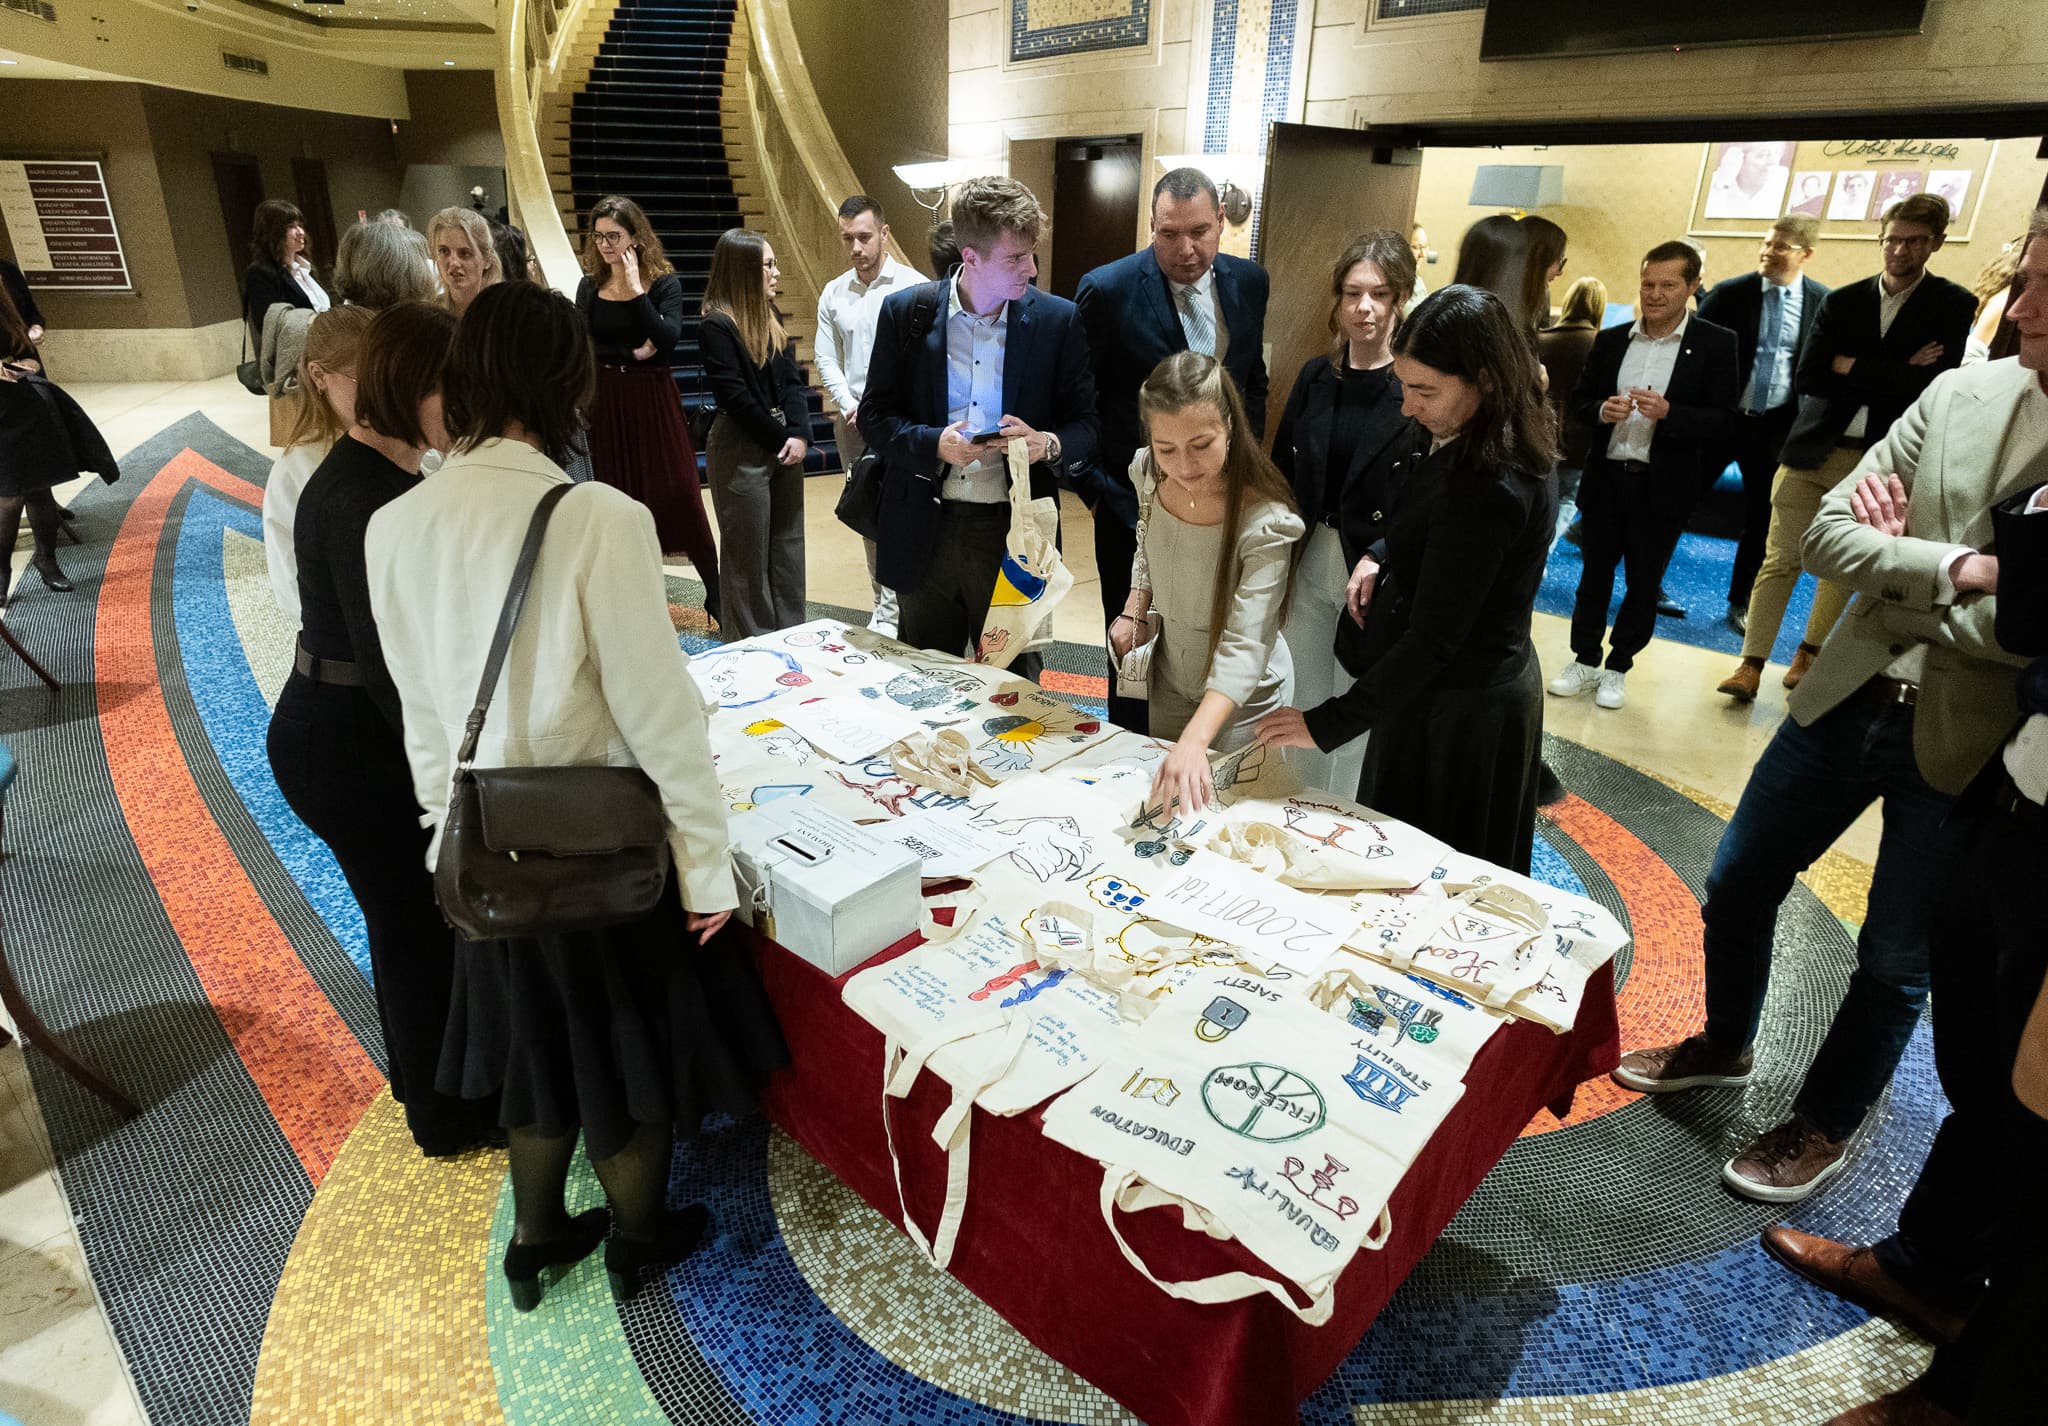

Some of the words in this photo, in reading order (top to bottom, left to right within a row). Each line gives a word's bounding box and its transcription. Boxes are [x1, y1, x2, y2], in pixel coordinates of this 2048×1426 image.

[1213, 976, 1284, 1002] SAFETY
[1350, 1037, 1432, 1092] STABILITY
[1214, 1071, 1317, 1124] FREEDOM
[1089, 1104, 1197, 1157] EDUCATION
[1224, 1164, 1341, 1253] EQUALITY
